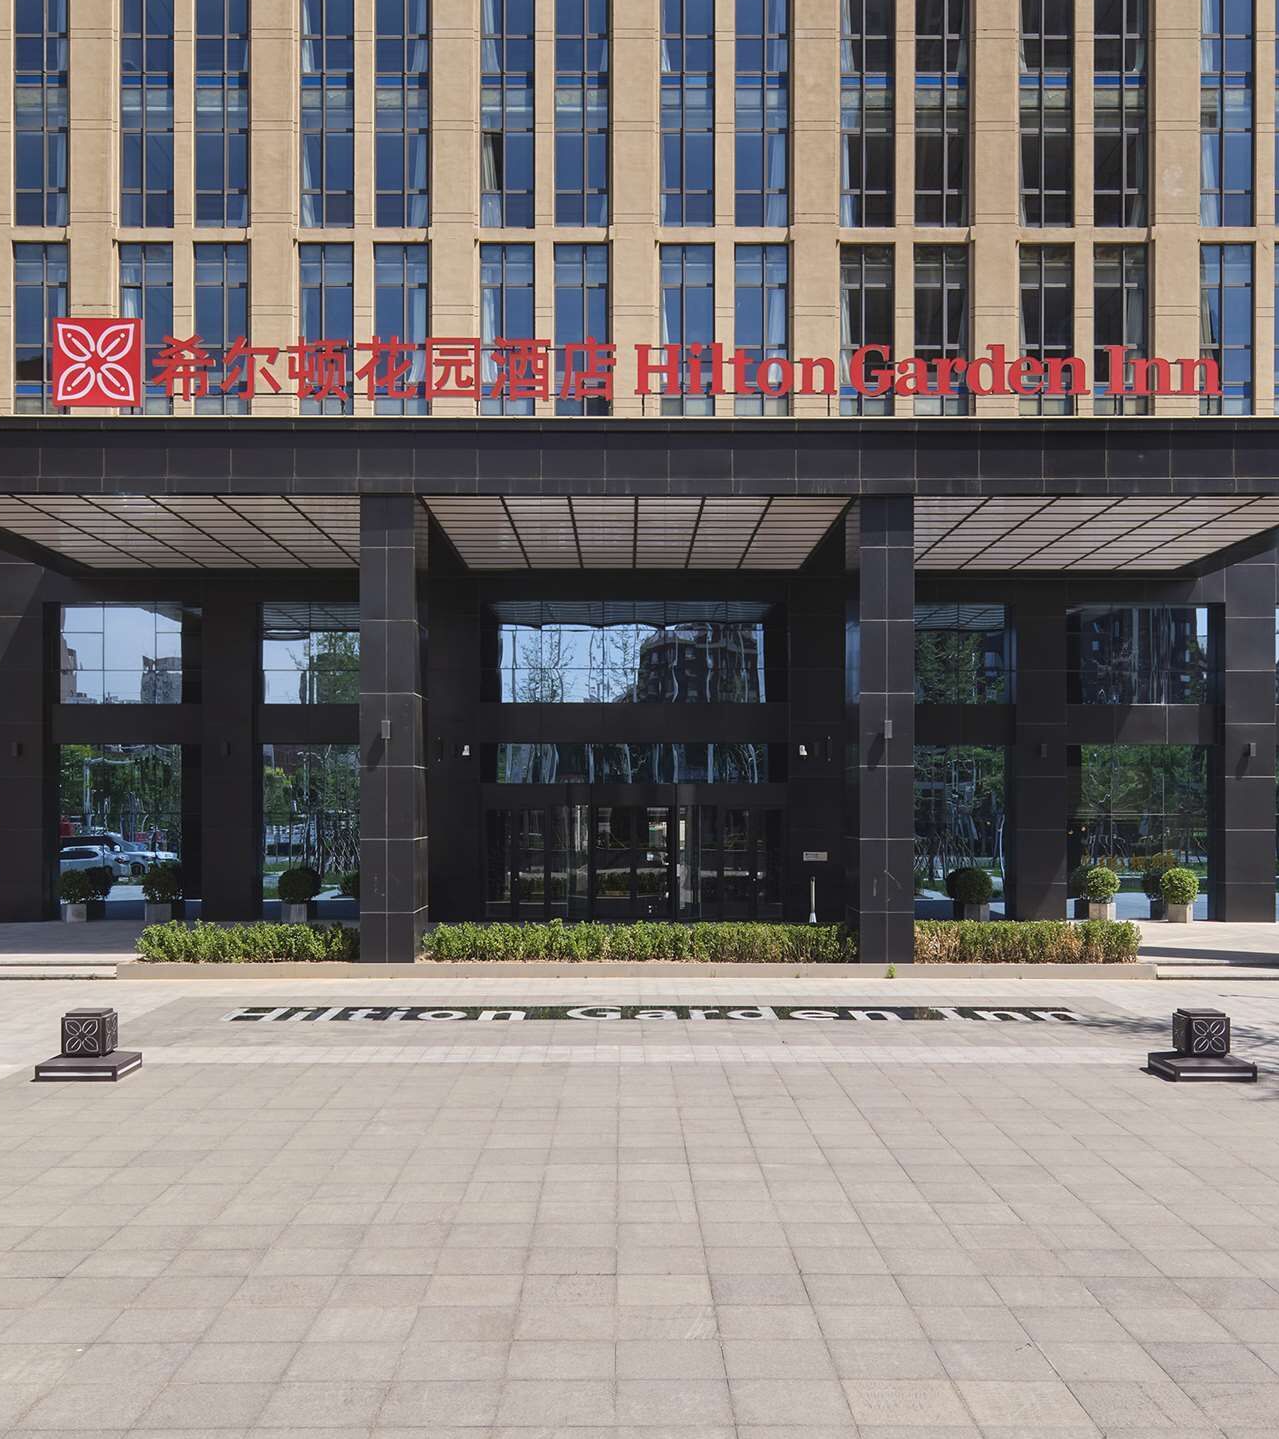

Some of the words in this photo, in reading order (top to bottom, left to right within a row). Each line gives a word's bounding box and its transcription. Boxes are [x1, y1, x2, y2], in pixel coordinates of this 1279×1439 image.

[151, 335, 616, 402] 希尔顿花园酒店
[634, 342, 838, 396] Hilton
[850, 343, 1092, 398] Garden
[1103, 344, 1223, 396] Inn
[222, 1006, 528, 1021] Hiltion
[565, 1005, 904, 1021] Garden
[928, 1007, 1086, 1022] Inn
